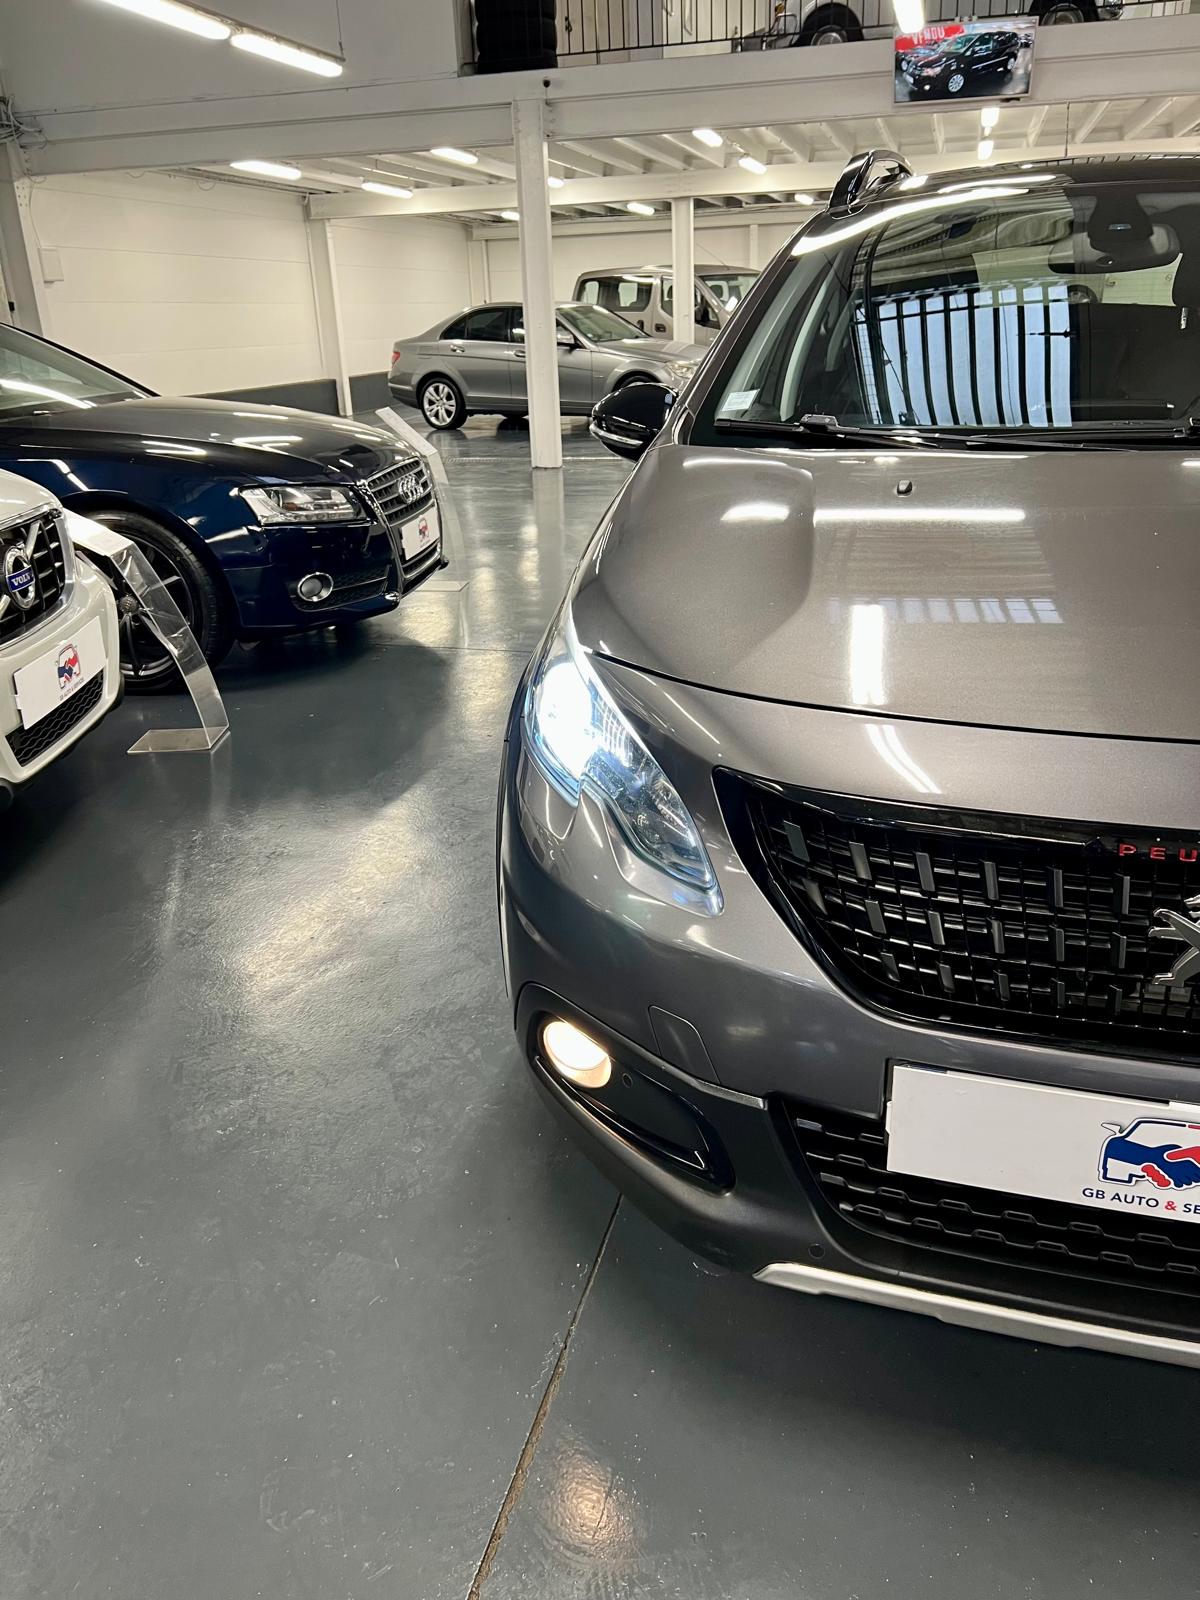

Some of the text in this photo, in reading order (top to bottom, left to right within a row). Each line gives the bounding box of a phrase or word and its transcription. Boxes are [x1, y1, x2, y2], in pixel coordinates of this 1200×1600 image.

[1119, 843, 1198, 862] PEU
[1082, 1187, 1106, 1200] GB
[1110, 1192, 1160, 1208] AUTO
[1164, 1200, 1178, 1212] &
